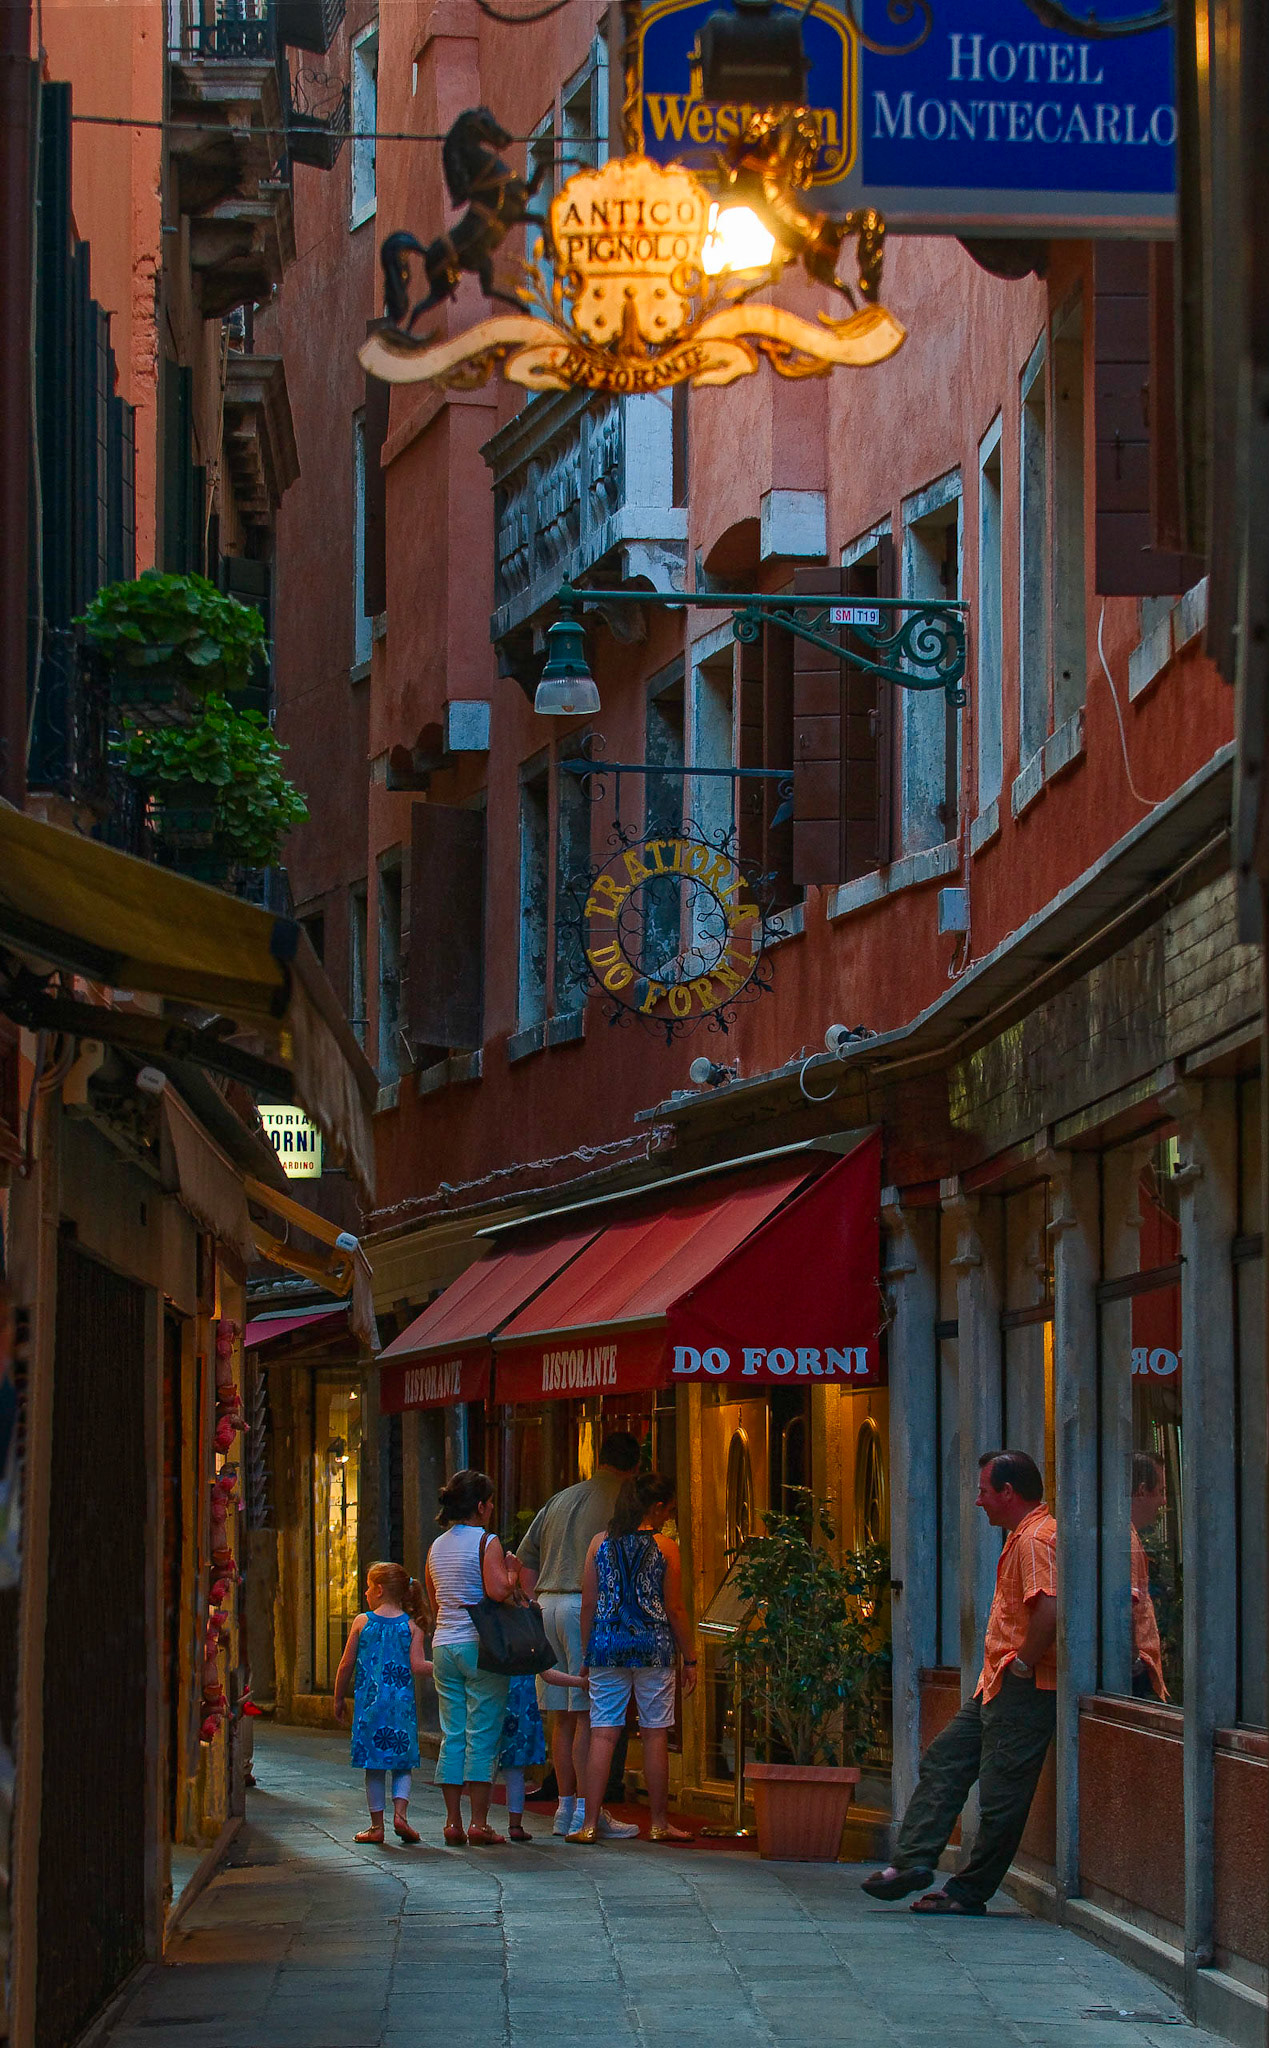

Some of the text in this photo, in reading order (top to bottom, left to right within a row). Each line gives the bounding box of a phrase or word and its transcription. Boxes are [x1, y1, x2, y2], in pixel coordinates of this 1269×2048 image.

[645, 93, 840, 146] Westn
[563, 200, 695, 228] ANTICO
[567, 234, 690, 264] PIGNOLO
[835, 610, 876, 622] SM T19
[584, 838, 761, 931] TRATTORIA
[587, 940, 758, 1018] DO FORNI
[541, 1344, 617, 1391] RISTORANTE
[672, 1345, 869, 1376] DO FORNI
[404, 1361, 462, 1403] RISTORANTE
